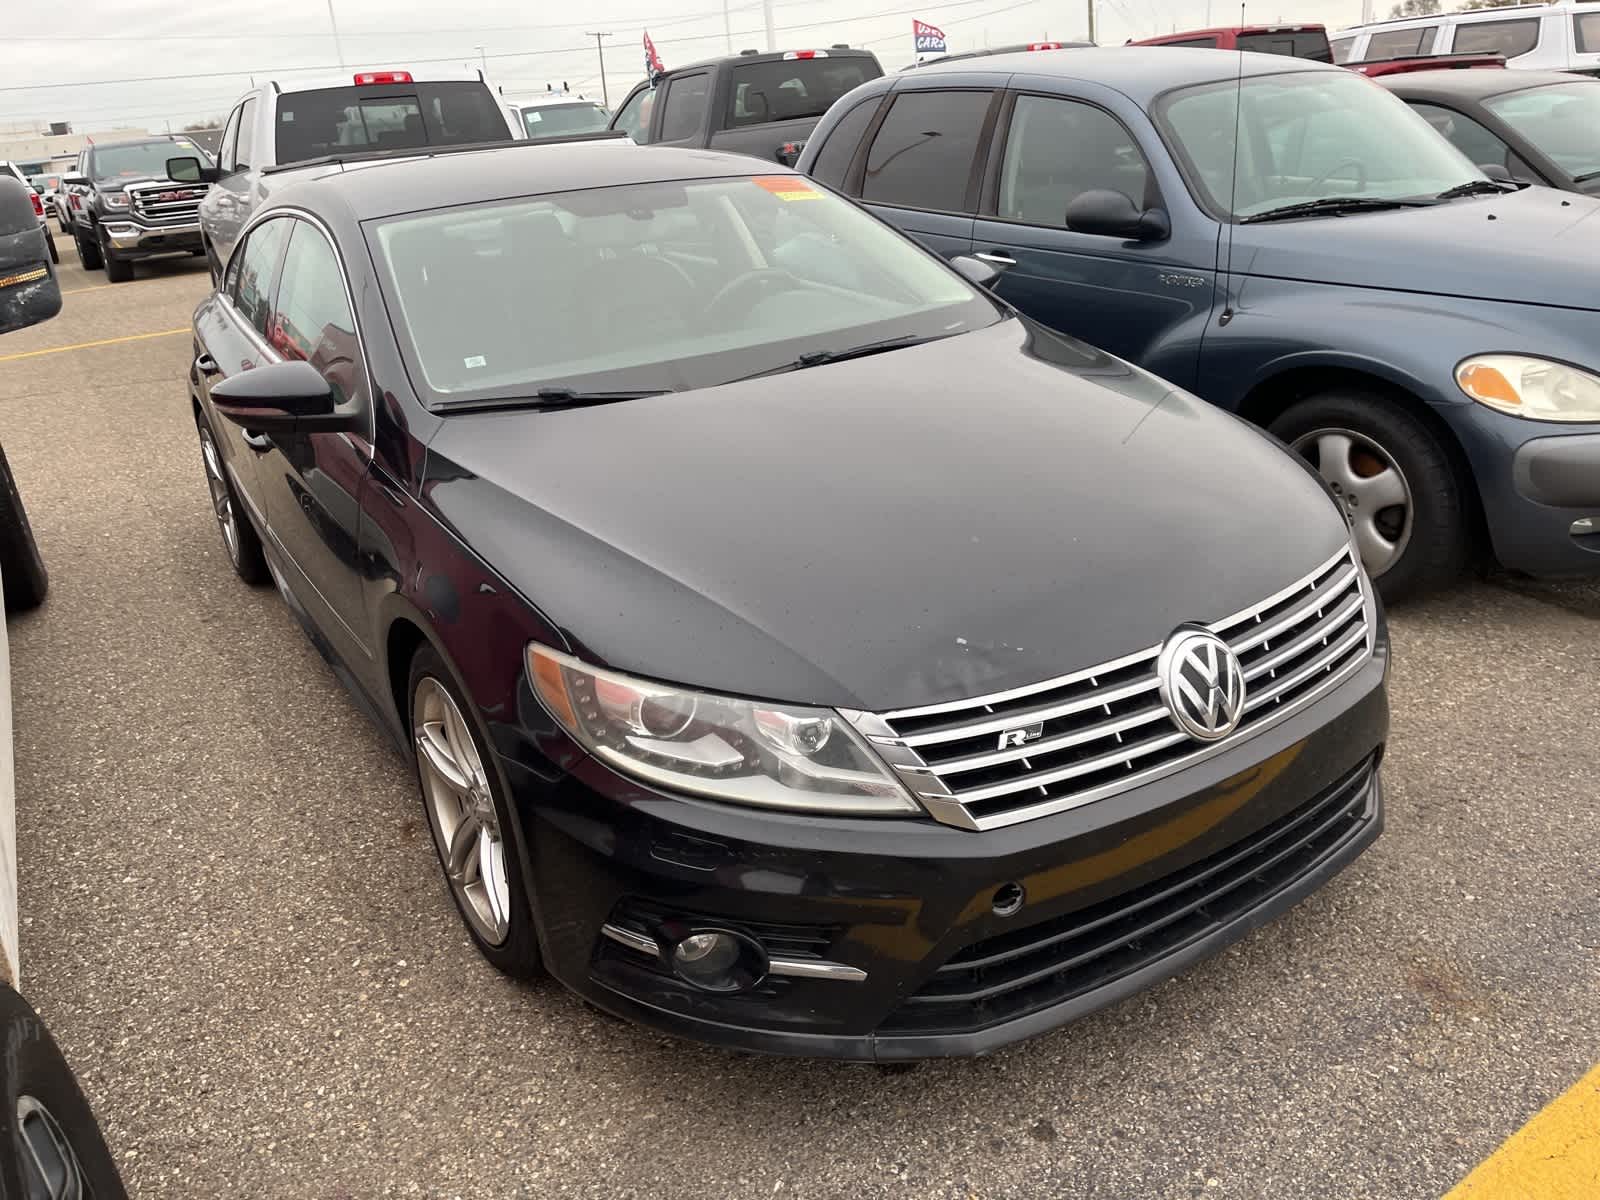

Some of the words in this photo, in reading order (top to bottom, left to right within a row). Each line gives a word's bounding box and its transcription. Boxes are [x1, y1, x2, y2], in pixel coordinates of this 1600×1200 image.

[917, 36, 944, 48] CARS
[160, 189, 193, 201] GMC
[1172, 636, 1243, 738] VW
[997, 730, 1026, 750] R
